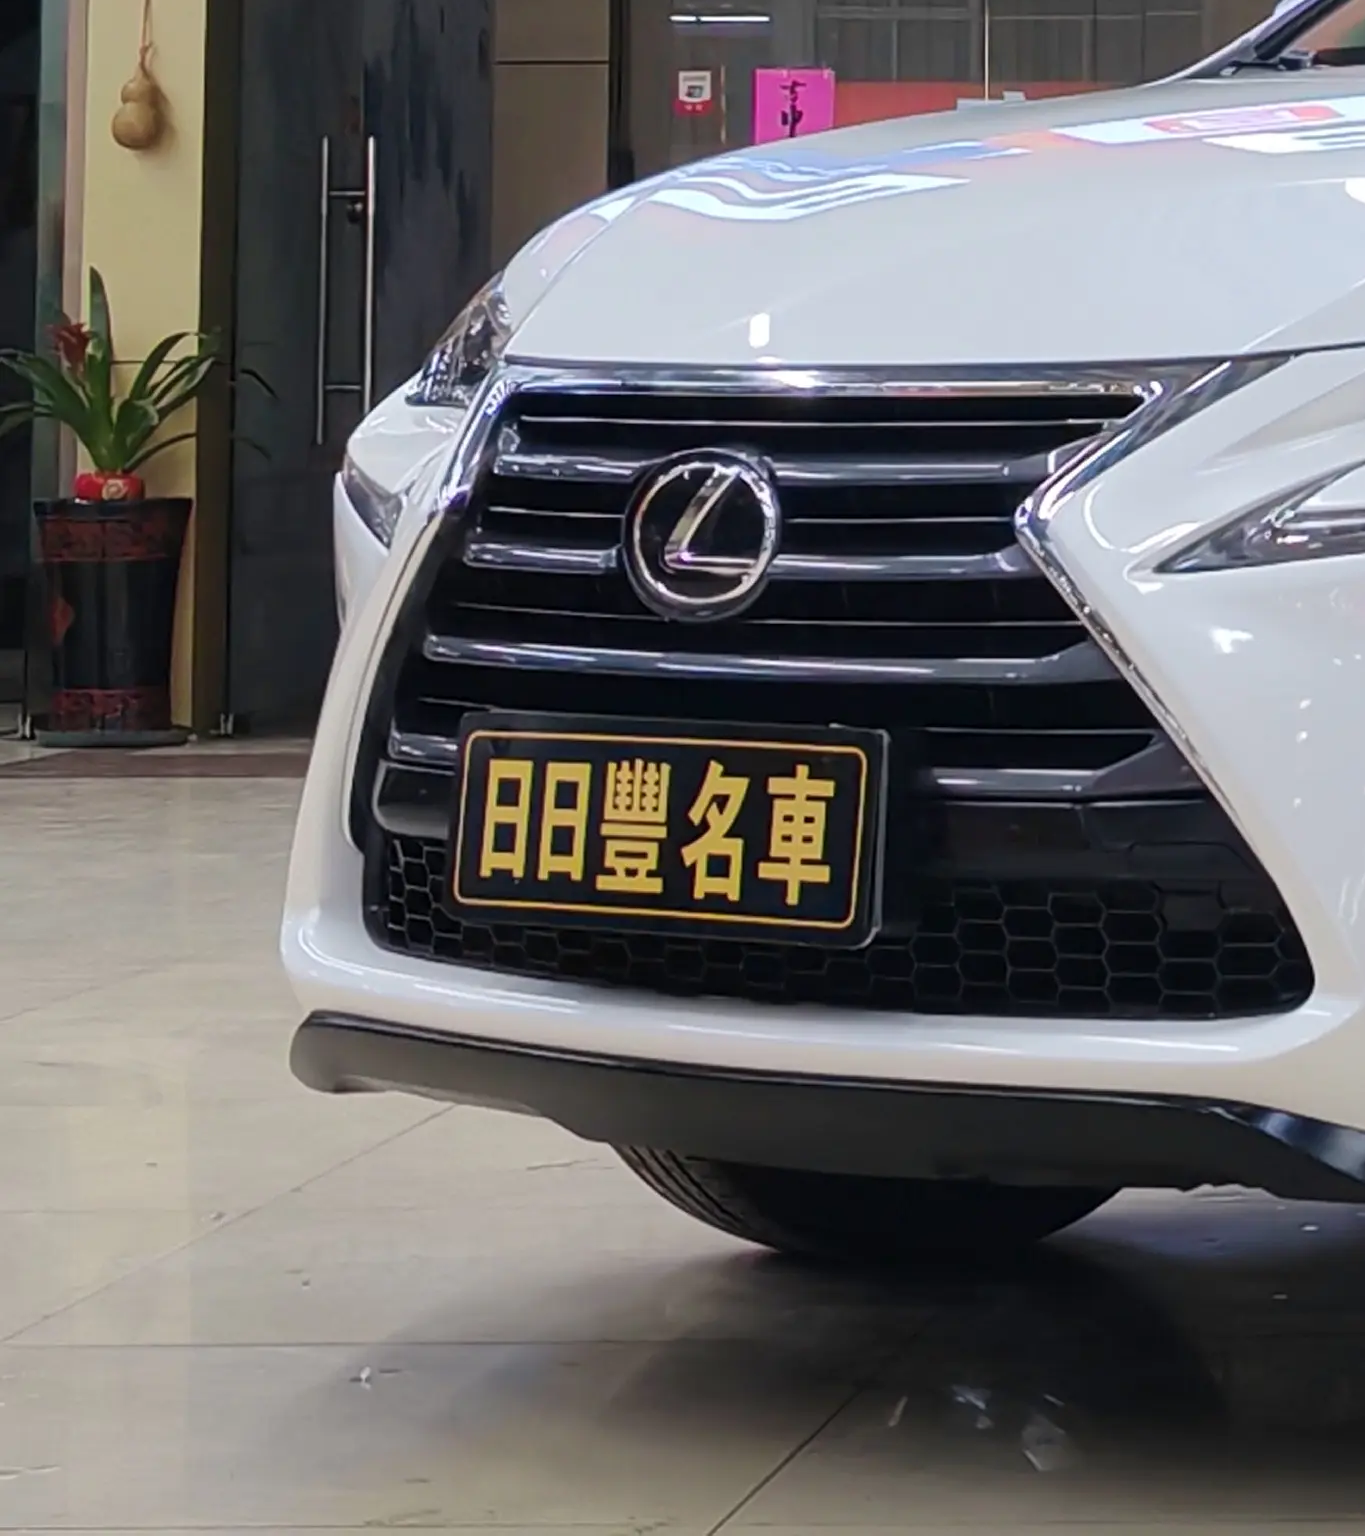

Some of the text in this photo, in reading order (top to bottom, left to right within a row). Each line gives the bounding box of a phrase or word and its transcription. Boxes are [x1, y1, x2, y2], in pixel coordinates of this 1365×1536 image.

[478, 757, 836, 906] 日日豐名車
